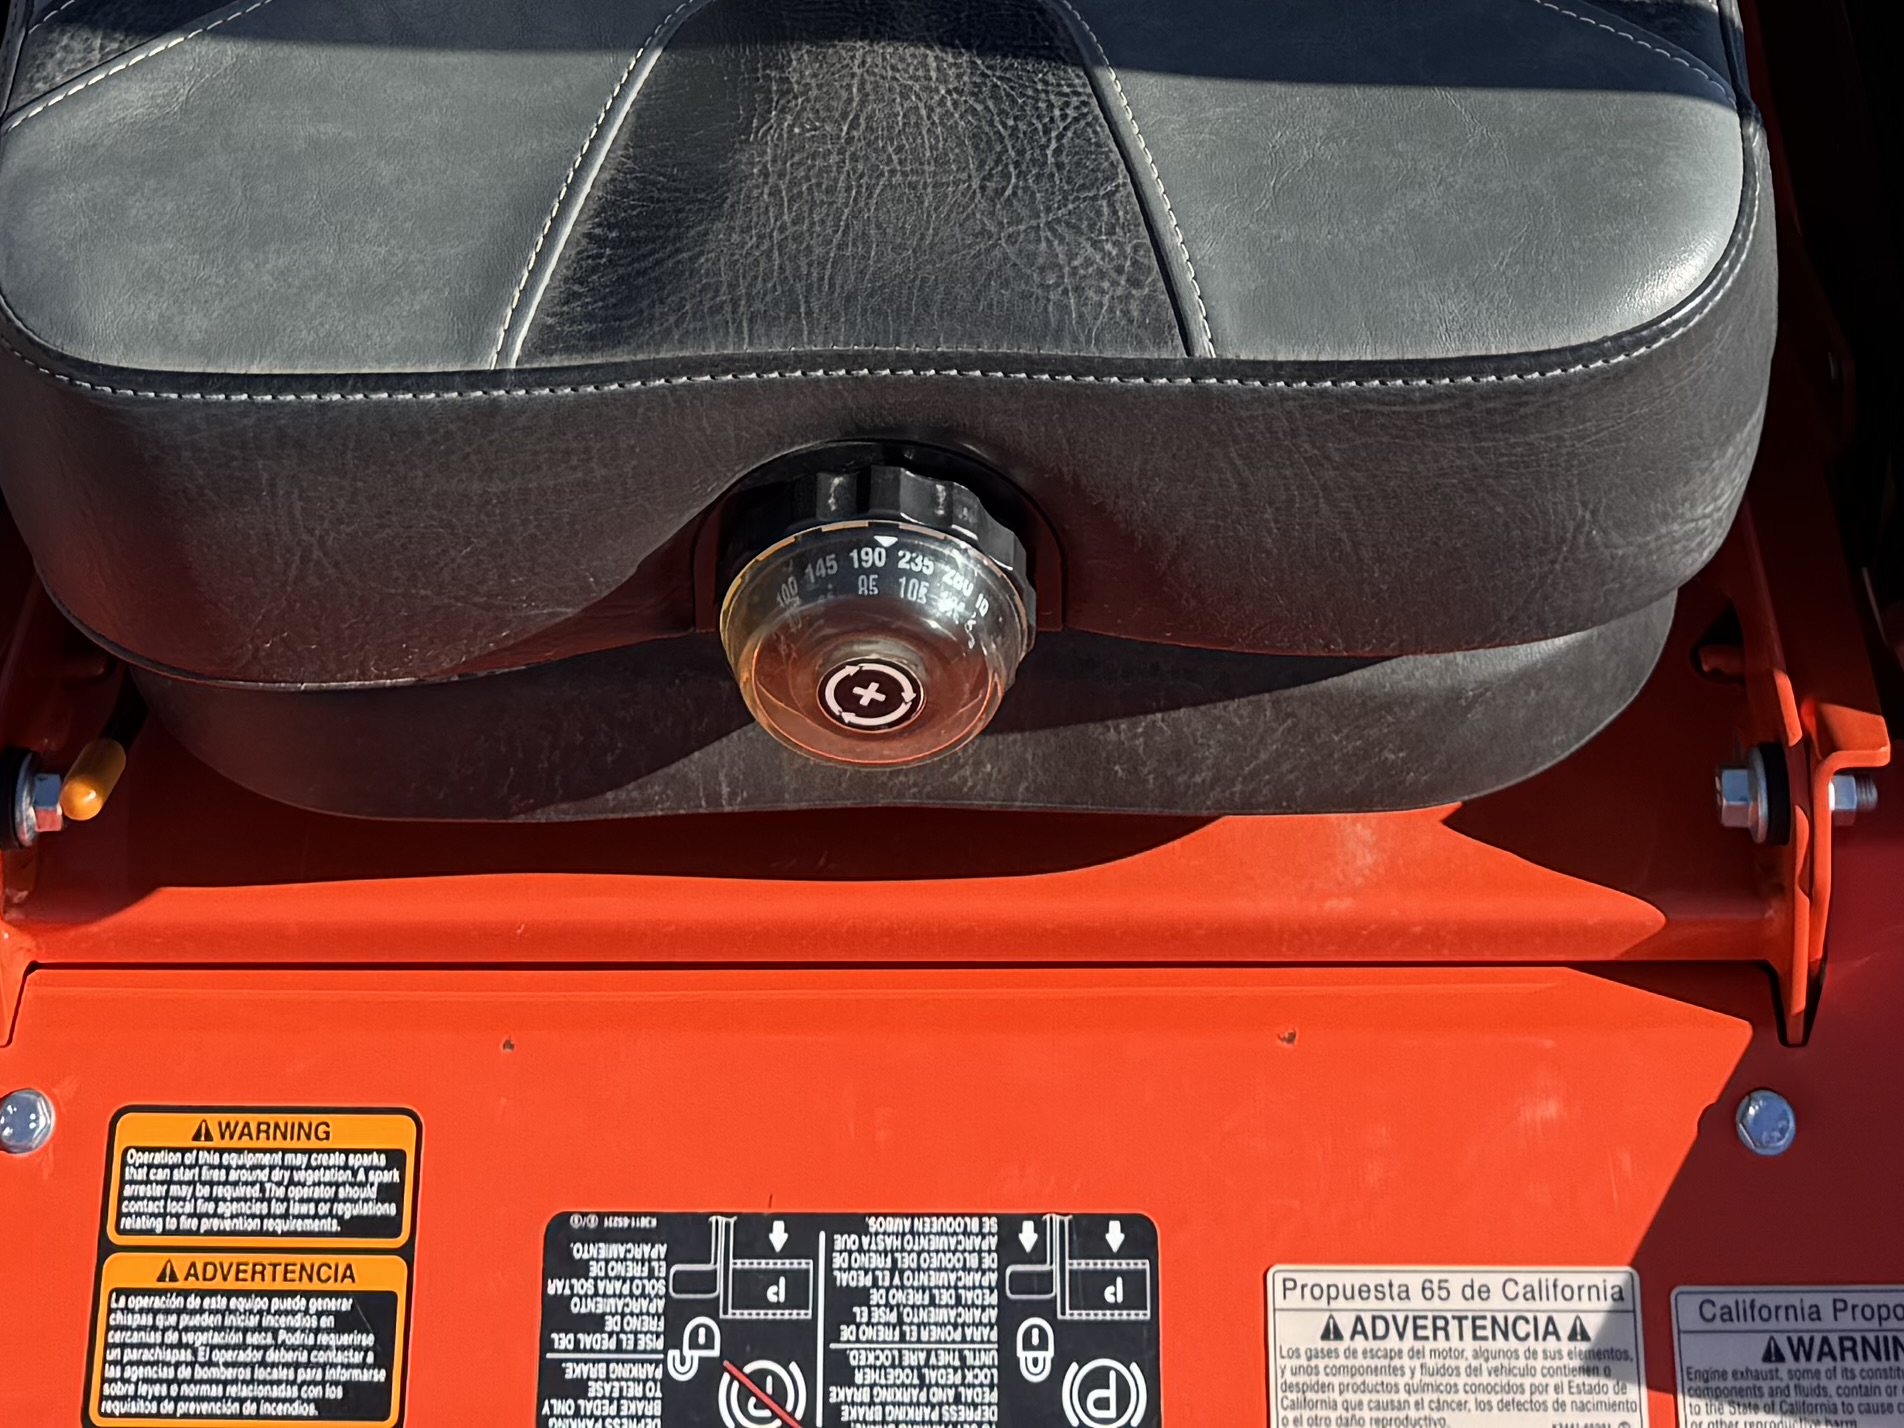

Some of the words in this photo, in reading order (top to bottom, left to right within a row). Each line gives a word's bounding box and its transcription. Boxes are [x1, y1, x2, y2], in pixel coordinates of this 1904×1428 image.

[804, 554, 838, 584] 145
[849, 547, 887, 569] 190
[898, 550, 935, 575] 235
[898, 576, 930, 605] 105
[217, 1120, 331, 1142] WARNING
[125, 1150, 182, 1166] Operation
[183, 1150, 196, 1164] of
[198, 1150, 220, 1164] this
[221, 1150, 281, 1167] equipment
[284, 1153, 308, 1167] may
[310, 1151, 345, 1165] create
[347, 1151, 387, 1168] sparks
[124, 1166, 147, 1180] that
[148, 1169, 170, 1180] can
[172, 1166, 199, 1180] start
[201, 1166, 226, 1181] fires
[228, 1167, 269, 1181] around
[270, 1167, 289, 1184] dry
[291, 1167, 355, 1184] vegetation.
[355, 1168, 365, 1182] A
[367, 1168, 400, 1185] spark
[569, 1242, 666, 1258] APARCAMIENTO.
[185, 1261, 356, 1284] ADVERTENCIA
[588, 1260, 604, 1276] DE
[607, 1260, 648, 1276] FRENO
[651, 1260, 666, 1276] EL
[546, 1278, 594, 1294] SOLTAR
[597, 1278, 629, 1294] PARA
[1282, 1278, 1410, 1305] Propuesta
[1421, 1278, 1451, 1301] 65
[1461, 1279, 1491, 1301] de
[1501, 1279, 1624, 1301] California
[110, 1294, 126, 1307] La
[186, 1295, 201, 1308] de
[202, 1295, 227, 1309] este
[229, 1295, 268, 1312] equipo
[270, 1296, 306, 1312] puede
[308, 1299, 352, 1313] generar
[570, 1296, 665, 1313] APARCAMIENTO
[1698, 1298, 1821, 1322] California
[604, 1315, 620, 1330] DE
[622, 1315, 663, 1331] FRENO
[1349, 1314, 1561, 1341] ADVERTENCIA
[550, 1333, 573, 1349] DEL
[576, 1333, 616, 1349] PEDAL
[619, 1333, 634, 1349] EL
[636, 1333, 663, 1349] PISE
[846, 1349, 898, 1365] LOCKED.
[901, 1349, 926, 1365] ARE
[928, 1349, 959, 1365] THEY
[963, 1349, 997, 1365] UNTIL
[1279, 1345, 1300, 1358] Los
[1304, 1349, 1339, 1361] gases
[1343, 1346, 1357, 1358] de
[1361, 1350, 1403, 1362] escape
[1407, 1346, 1425, 1359] del
[1429, 1346, 1468, 1362] motor,
[1472, 1346, 1519, 1362] algunos
[1523, 1346, 1538, 1359] de
[1542, 1350, 1562, 1359] sus
[1567, 1347, 1632, 1363] elementos,
[561, 1362, 605, 1378] BRAKE.
[608, 1363, 662, 1378] PARKING
[854, 1368, 918, 1383] TOGETHER
[921, 1368, 961, 1383] PEDAL
[964, 1368, 997, 1383] LOCK
[1280, 1366, 1286, 1378] y
[1290, 1366, 1319, 1375] unos
[1324, 1362, 1405, 1378] componentes
[1409, 1366, 1416, 1378] y
[1420, 1362, 1460, 1375] fluidos
[1464, 1363, 1482, 1375] del
[1540, 1363, 1599, 1376] contienen
[1603, 1367, 1611, 1376] o
[1686, 1366, 1728, 1383] Engine
[1730, 1366, 1783, 1382] exhaust,
[1787, 1369, 1820, 1379] some
[1824, 1365, 1838, 1379] of
[1840, 1365, 1856, 1379] its
[587, 1380, 642, 1397] RELEASE
[645, 1381, 662, 1397] TO
[1280, 1380, 1334, 1396] despiden
[1338, 1380, 1399, 1396] productos
[1463, 1381, 1525, 1394] conocidos
[1529, 1385, 1549, 1397] por
[1553, 1381, 1563, 1394] el
[1567, 1381, 1609, 1394] Estado
[1612, 1381, 1627, 1394] de
[542, 1398, 574, 1414] ONLY
[577, 1399, 616, 1415] PEDAL
[619, 1399, 661, 1415] BRAKE
[1688, 1401, 1701, 1415] to
[1705, 1401, 1724, 1415] the
[1728, 1401, 1759, 1414] State
[1762, 1401, 1777, 1414] of
[1779, 1400, 1838, 1414] California
[1840, 1400, 1853, 1414] to
[1857, 1404, 1894, 1413] cause
